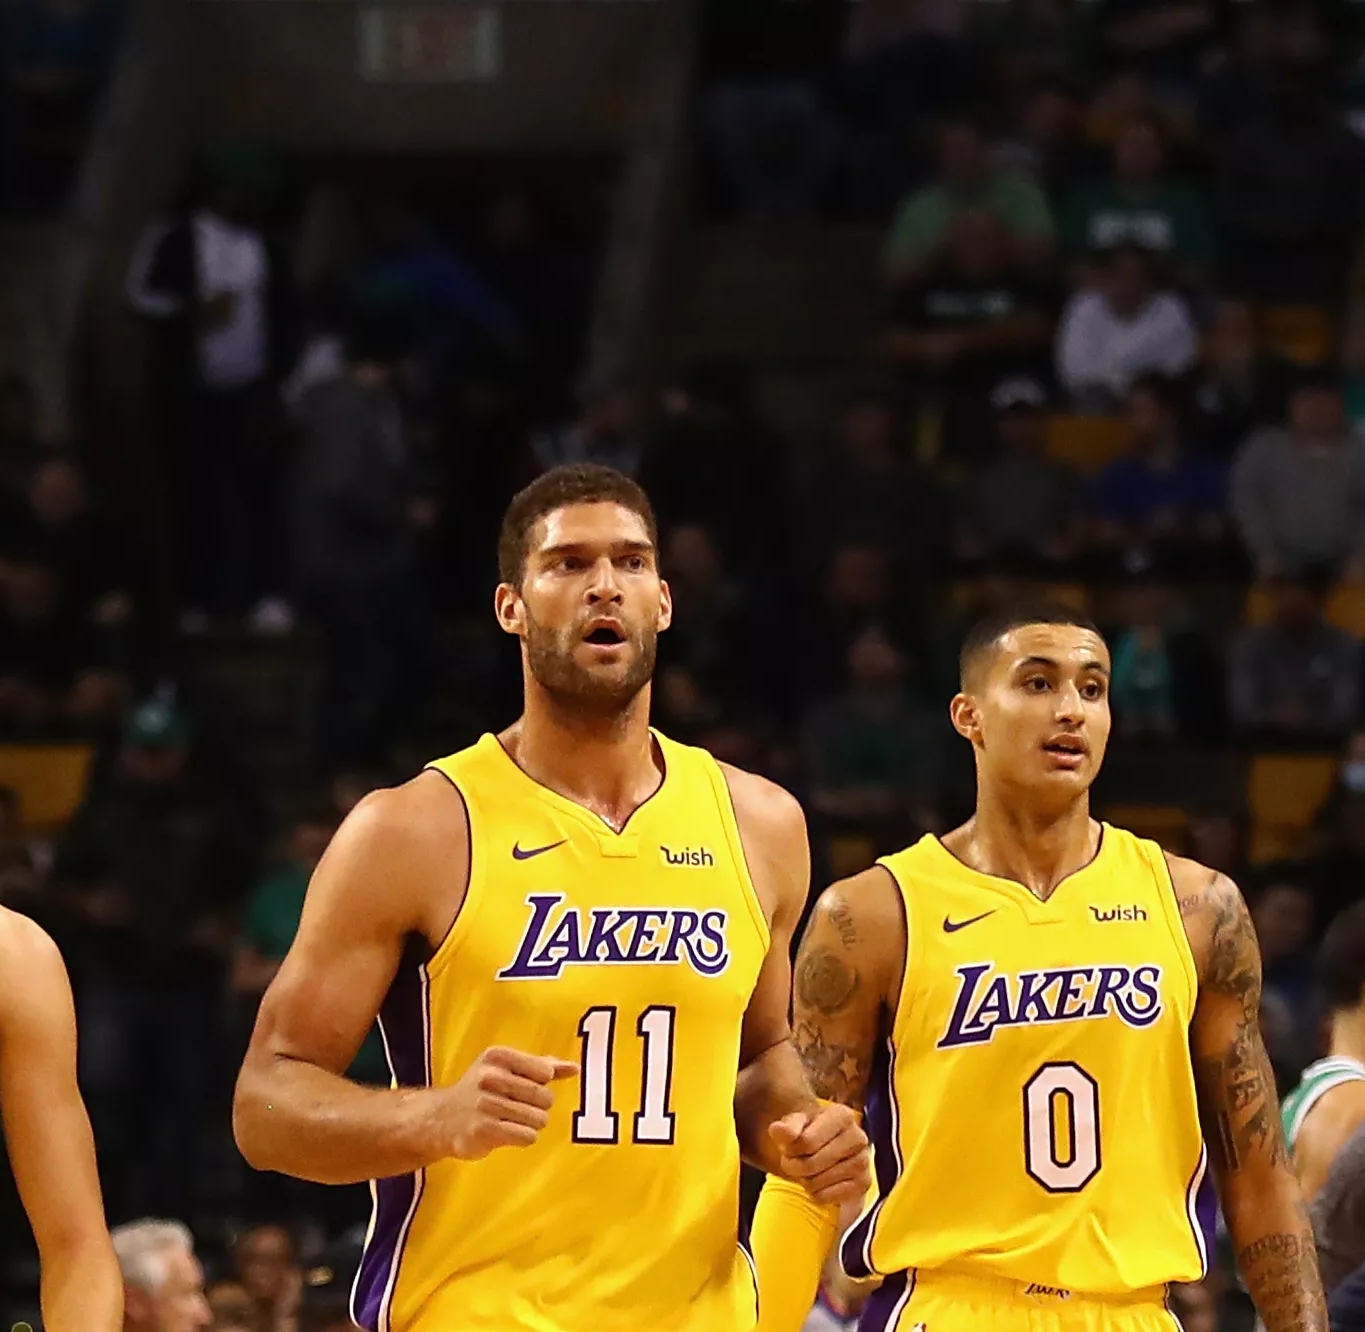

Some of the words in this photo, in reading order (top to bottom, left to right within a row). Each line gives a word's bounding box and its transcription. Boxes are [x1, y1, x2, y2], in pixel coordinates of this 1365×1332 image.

[660, 845, 715, 867] wish
[495, 892, 731, 981] LAKERS
[1089, 905, 1147, 923] wish
[936, 962, 1165, 1050] LAKERS
[572, 1005, 677, 1146] 11
[1022, 1061, 1103, 1194] 0
